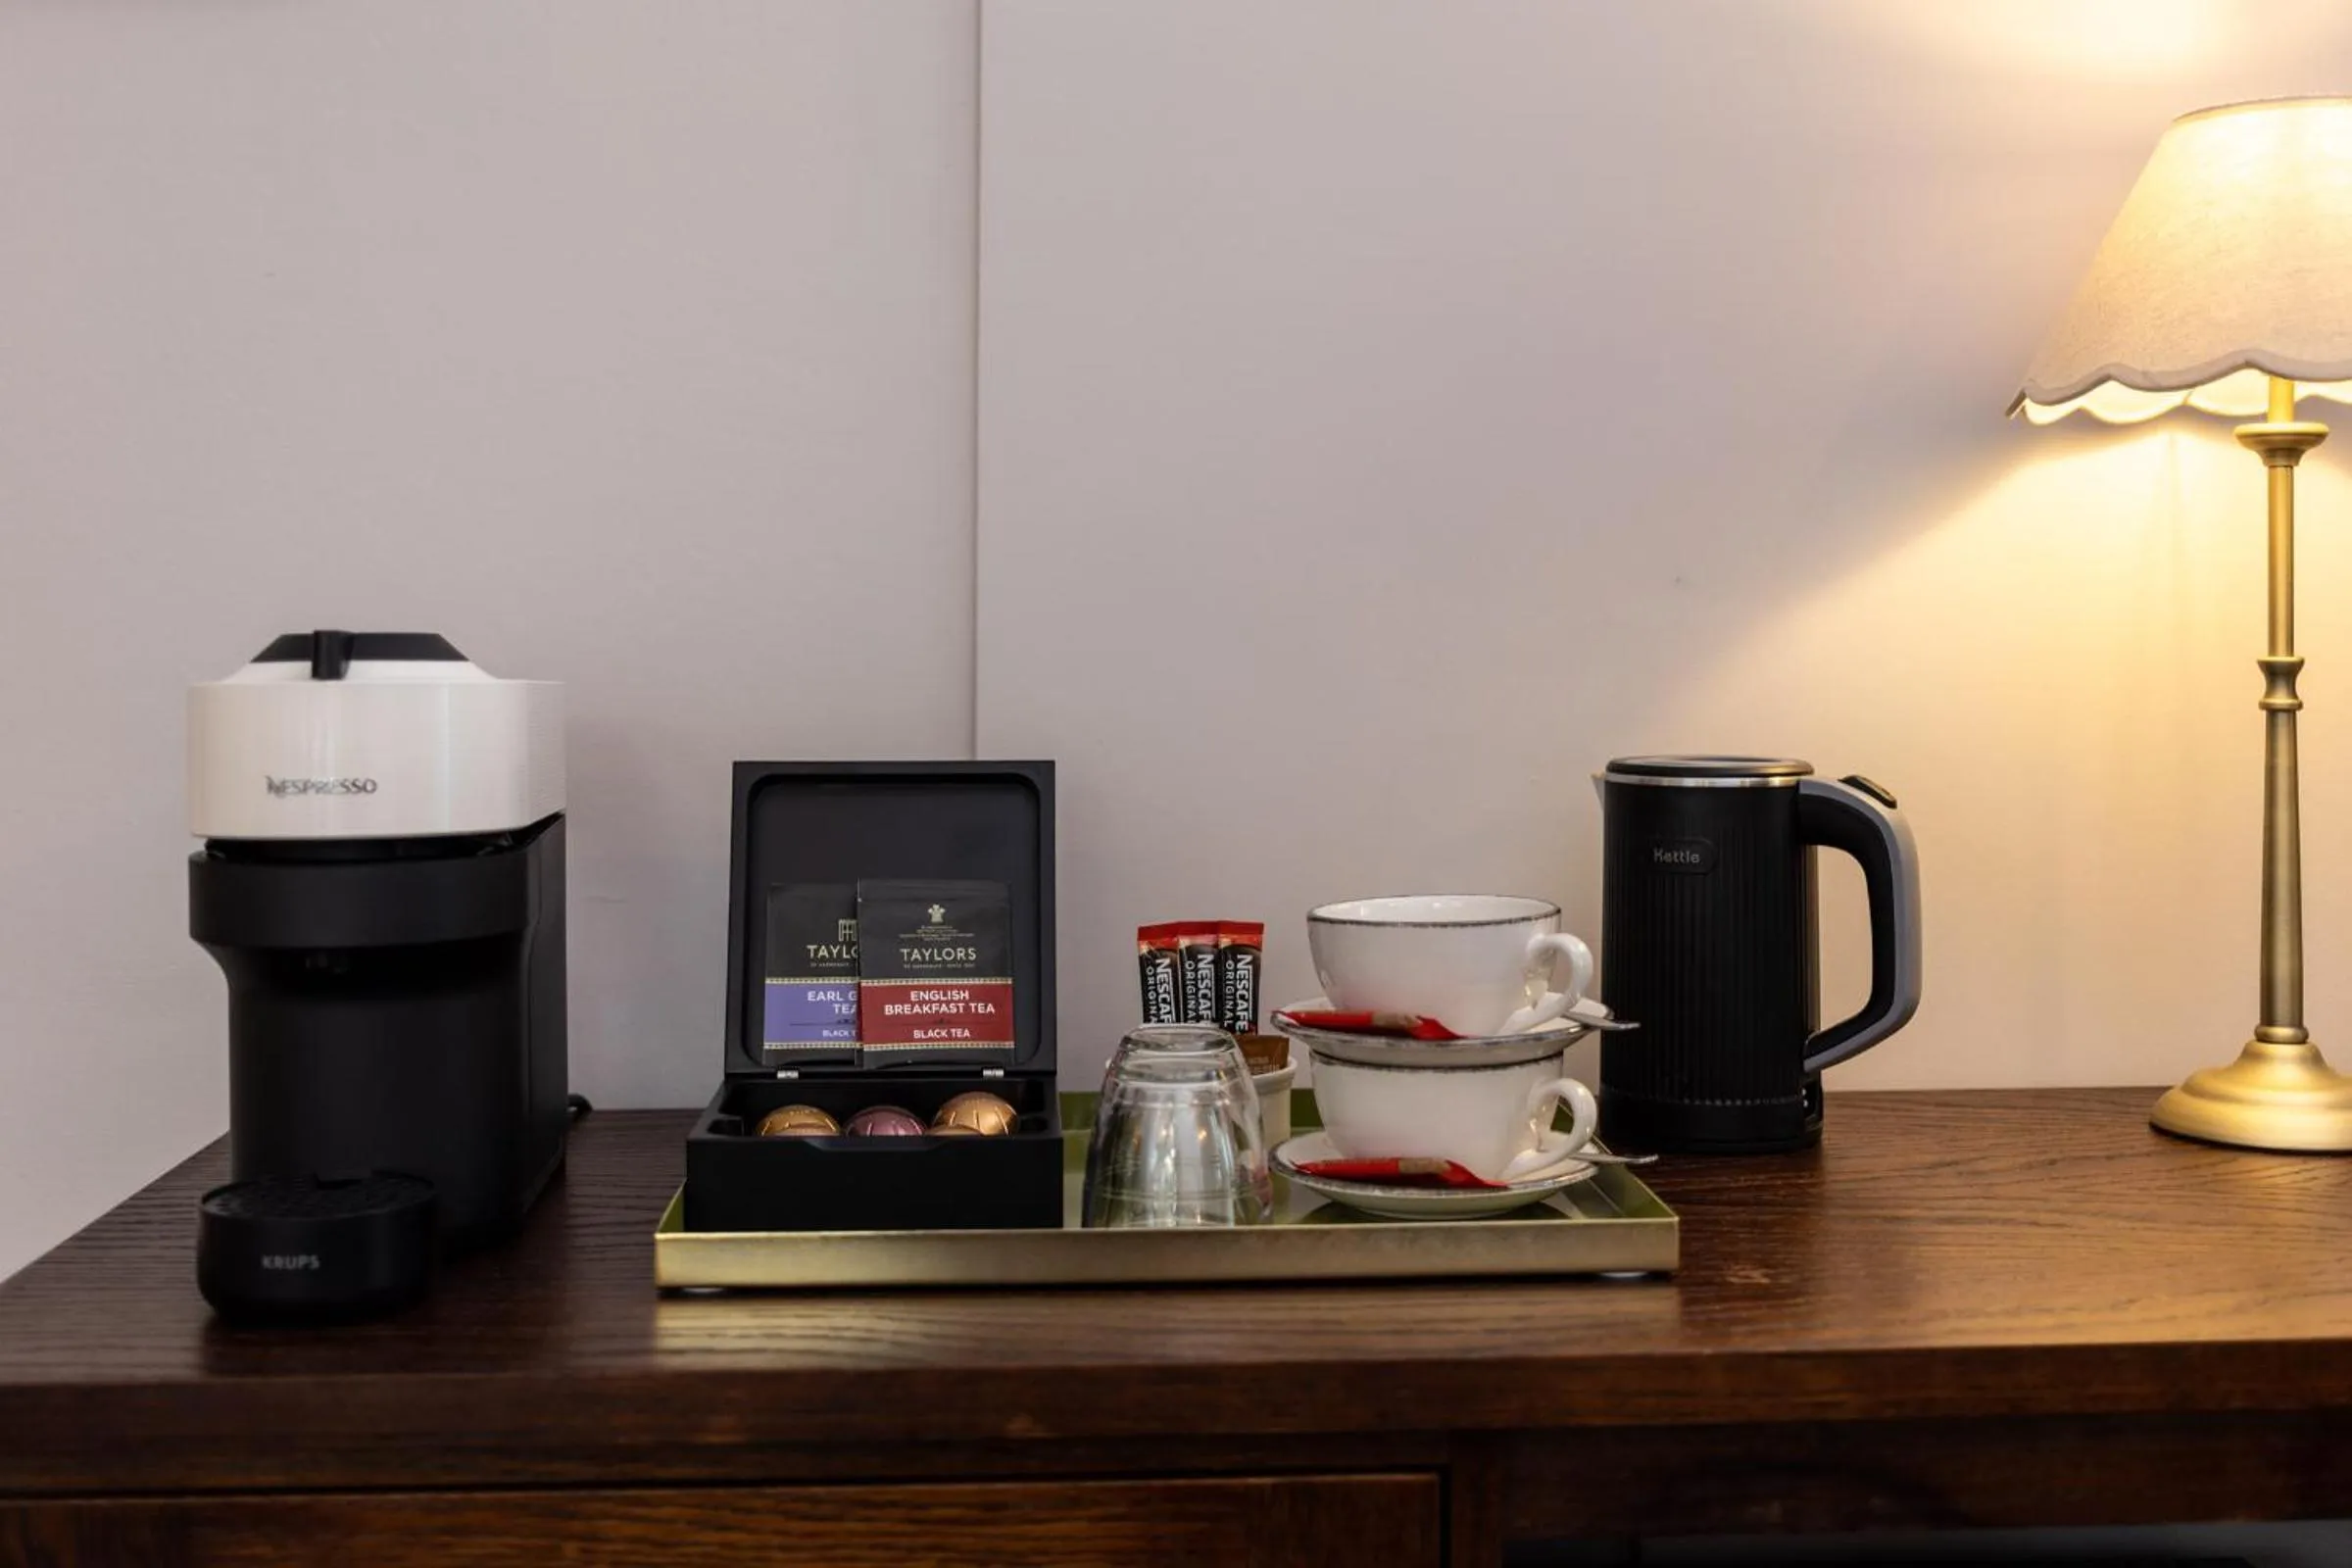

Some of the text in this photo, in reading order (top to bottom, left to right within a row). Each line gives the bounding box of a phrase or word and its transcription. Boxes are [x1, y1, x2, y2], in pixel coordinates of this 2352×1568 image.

[265, 775, 378, 798] NESPRESSO
[1653, 848, 1700, 863] Kettle
[807, 945, 858, 959] TAYL
[900, 948, 977, 961] TAYLORS
[807, 991, 844, 1002] EARL
[910, 990, 970, 1001] ENGLISH
[1146, 965, 1158, 1024] ORIGINA
[1155, 957, 1175, 1024] NESCAF
[1224, 960, 1235, 1027] ORIGINAL
[884, 1003, 995, 1015] BREAKFAST TEA
[822, 1029, 850, 1038] BLACK
[913, 1028, 971, 1039] BLACK TEA
[262, 1254, 319, 1270] KRUPS
